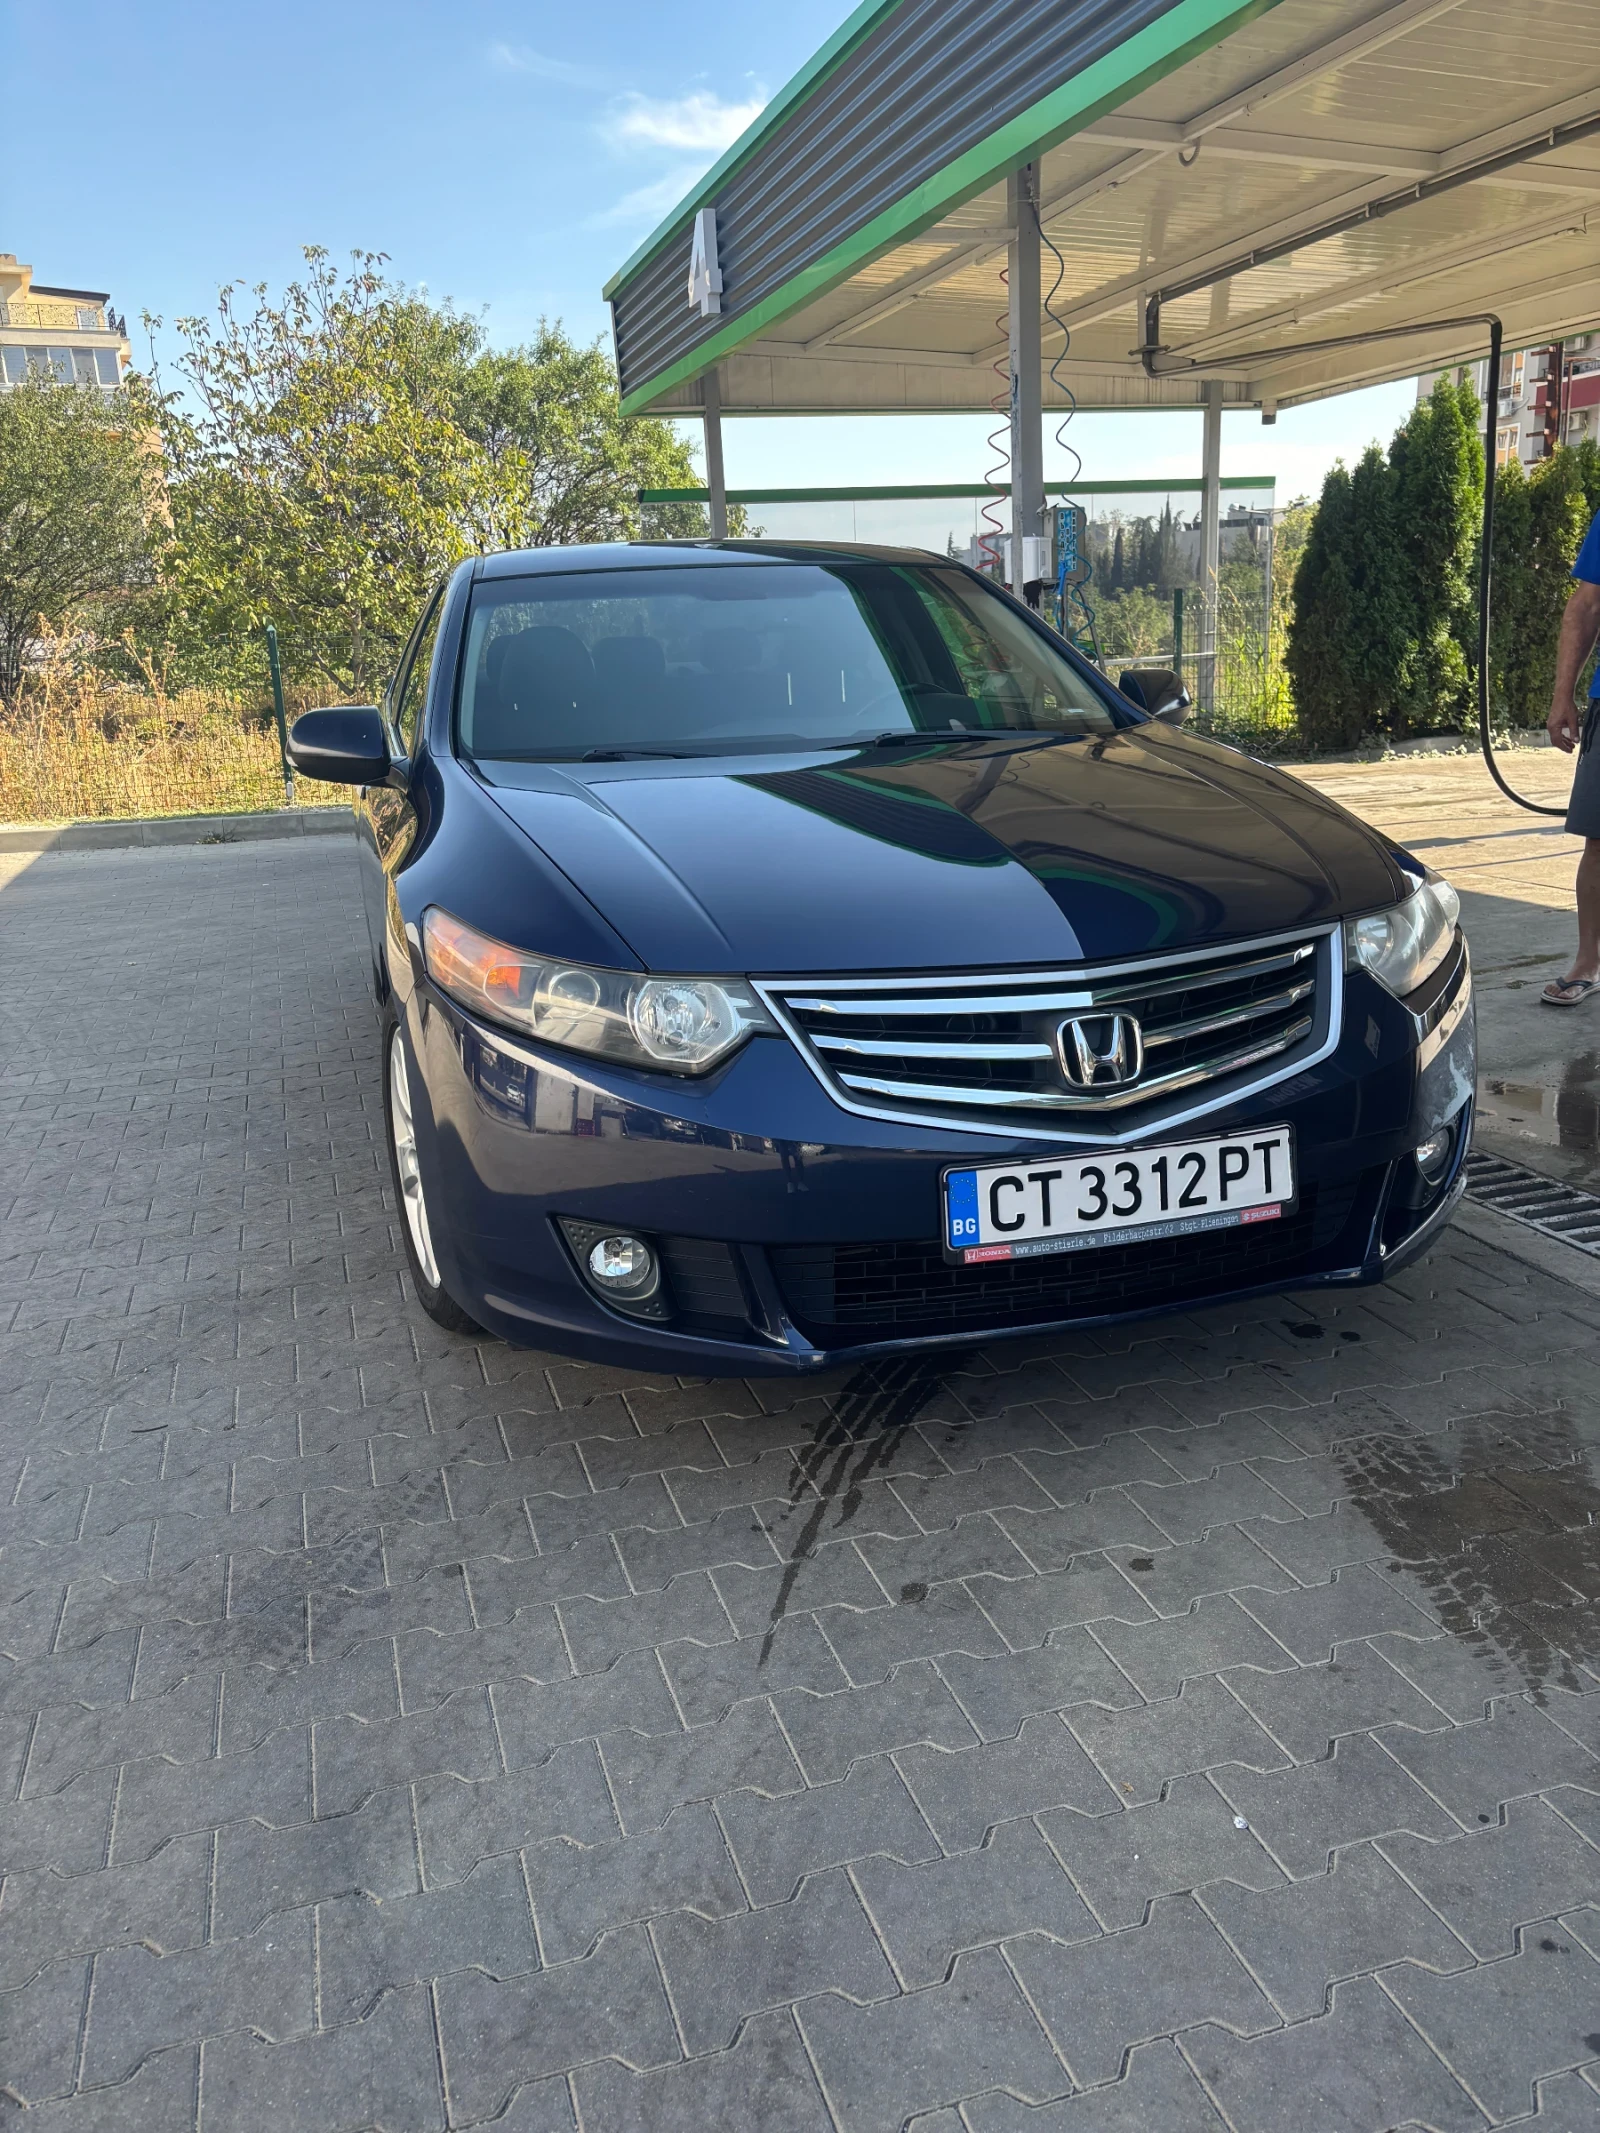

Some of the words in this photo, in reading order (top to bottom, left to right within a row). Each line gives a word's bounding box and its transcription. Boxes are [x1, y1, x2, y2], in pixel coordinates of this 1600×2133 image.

[688, 208, 723, 318] 4
[989, 1170, 1062, 1232] CT
[1077, 1152, 1207, 1221] 3312
[1219, 1139, 1281, 1202] PT
[953, 1217, 977, 1236] BG
[978, 1248, 1011, 1258] HONDA
[1015, 1236, 1096, 1255] www.auto-stierle.de
